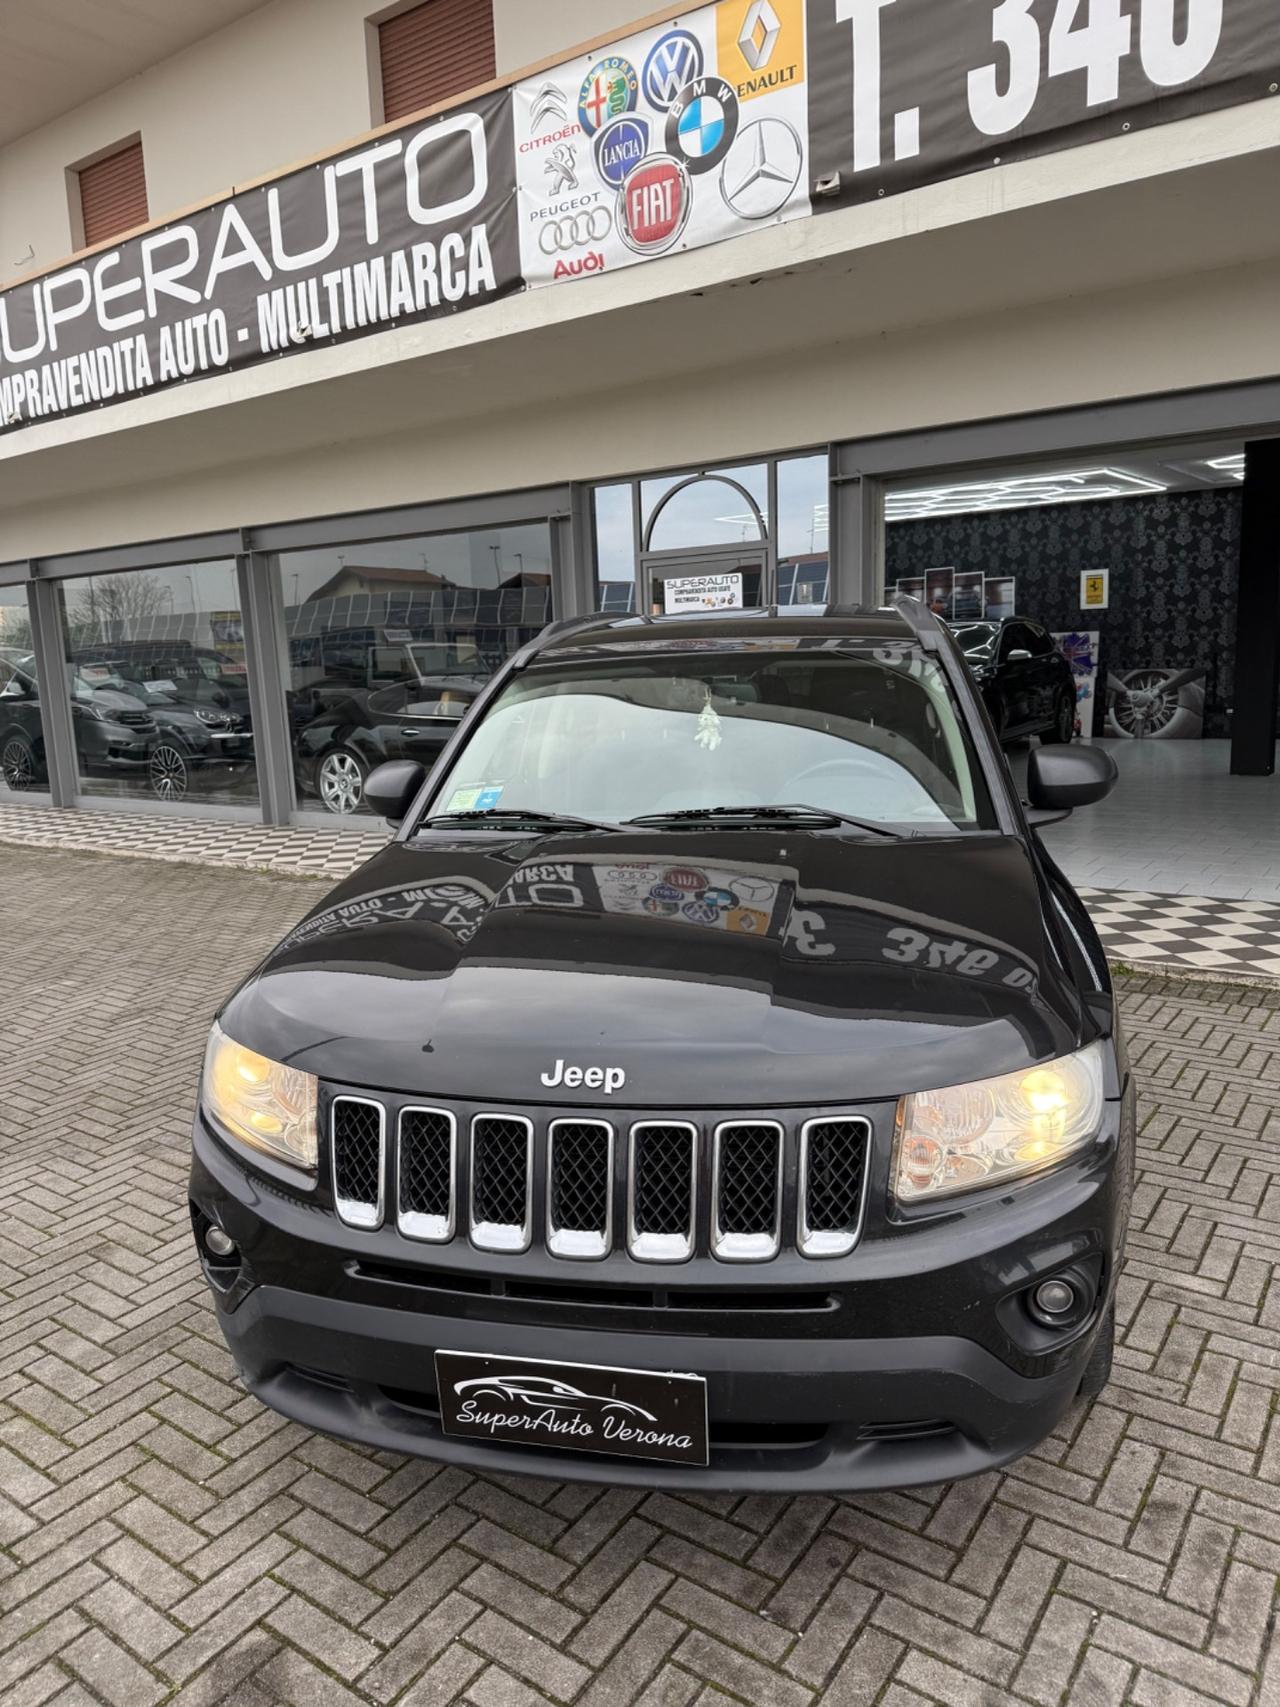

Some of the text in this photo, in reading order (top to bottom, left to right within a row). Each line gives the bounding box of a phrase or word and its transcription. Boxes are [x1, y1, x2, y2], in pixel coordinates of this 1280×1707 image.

[671, 81, 732, 119] BMW
[735, 64, 798, 98] ENAULT
[835, 0, 920, 172] T.
[604, 139, 641, 167] LANCIA
[530, 192, 601, 222] PEUGEOT
[632, 178, 676, 230] FIAT
[0, 112, 488, 364] UPERAUTO
[160, 308, 230, 382] AUTO
[257, 224, 497, 353] MULTIMARCA
[667, 575, 739, 589] SUPERAUTO
[541, 1059, 625, 1094] Jeep
[456, 1400, 693, 1449] SuperAuto Verona
